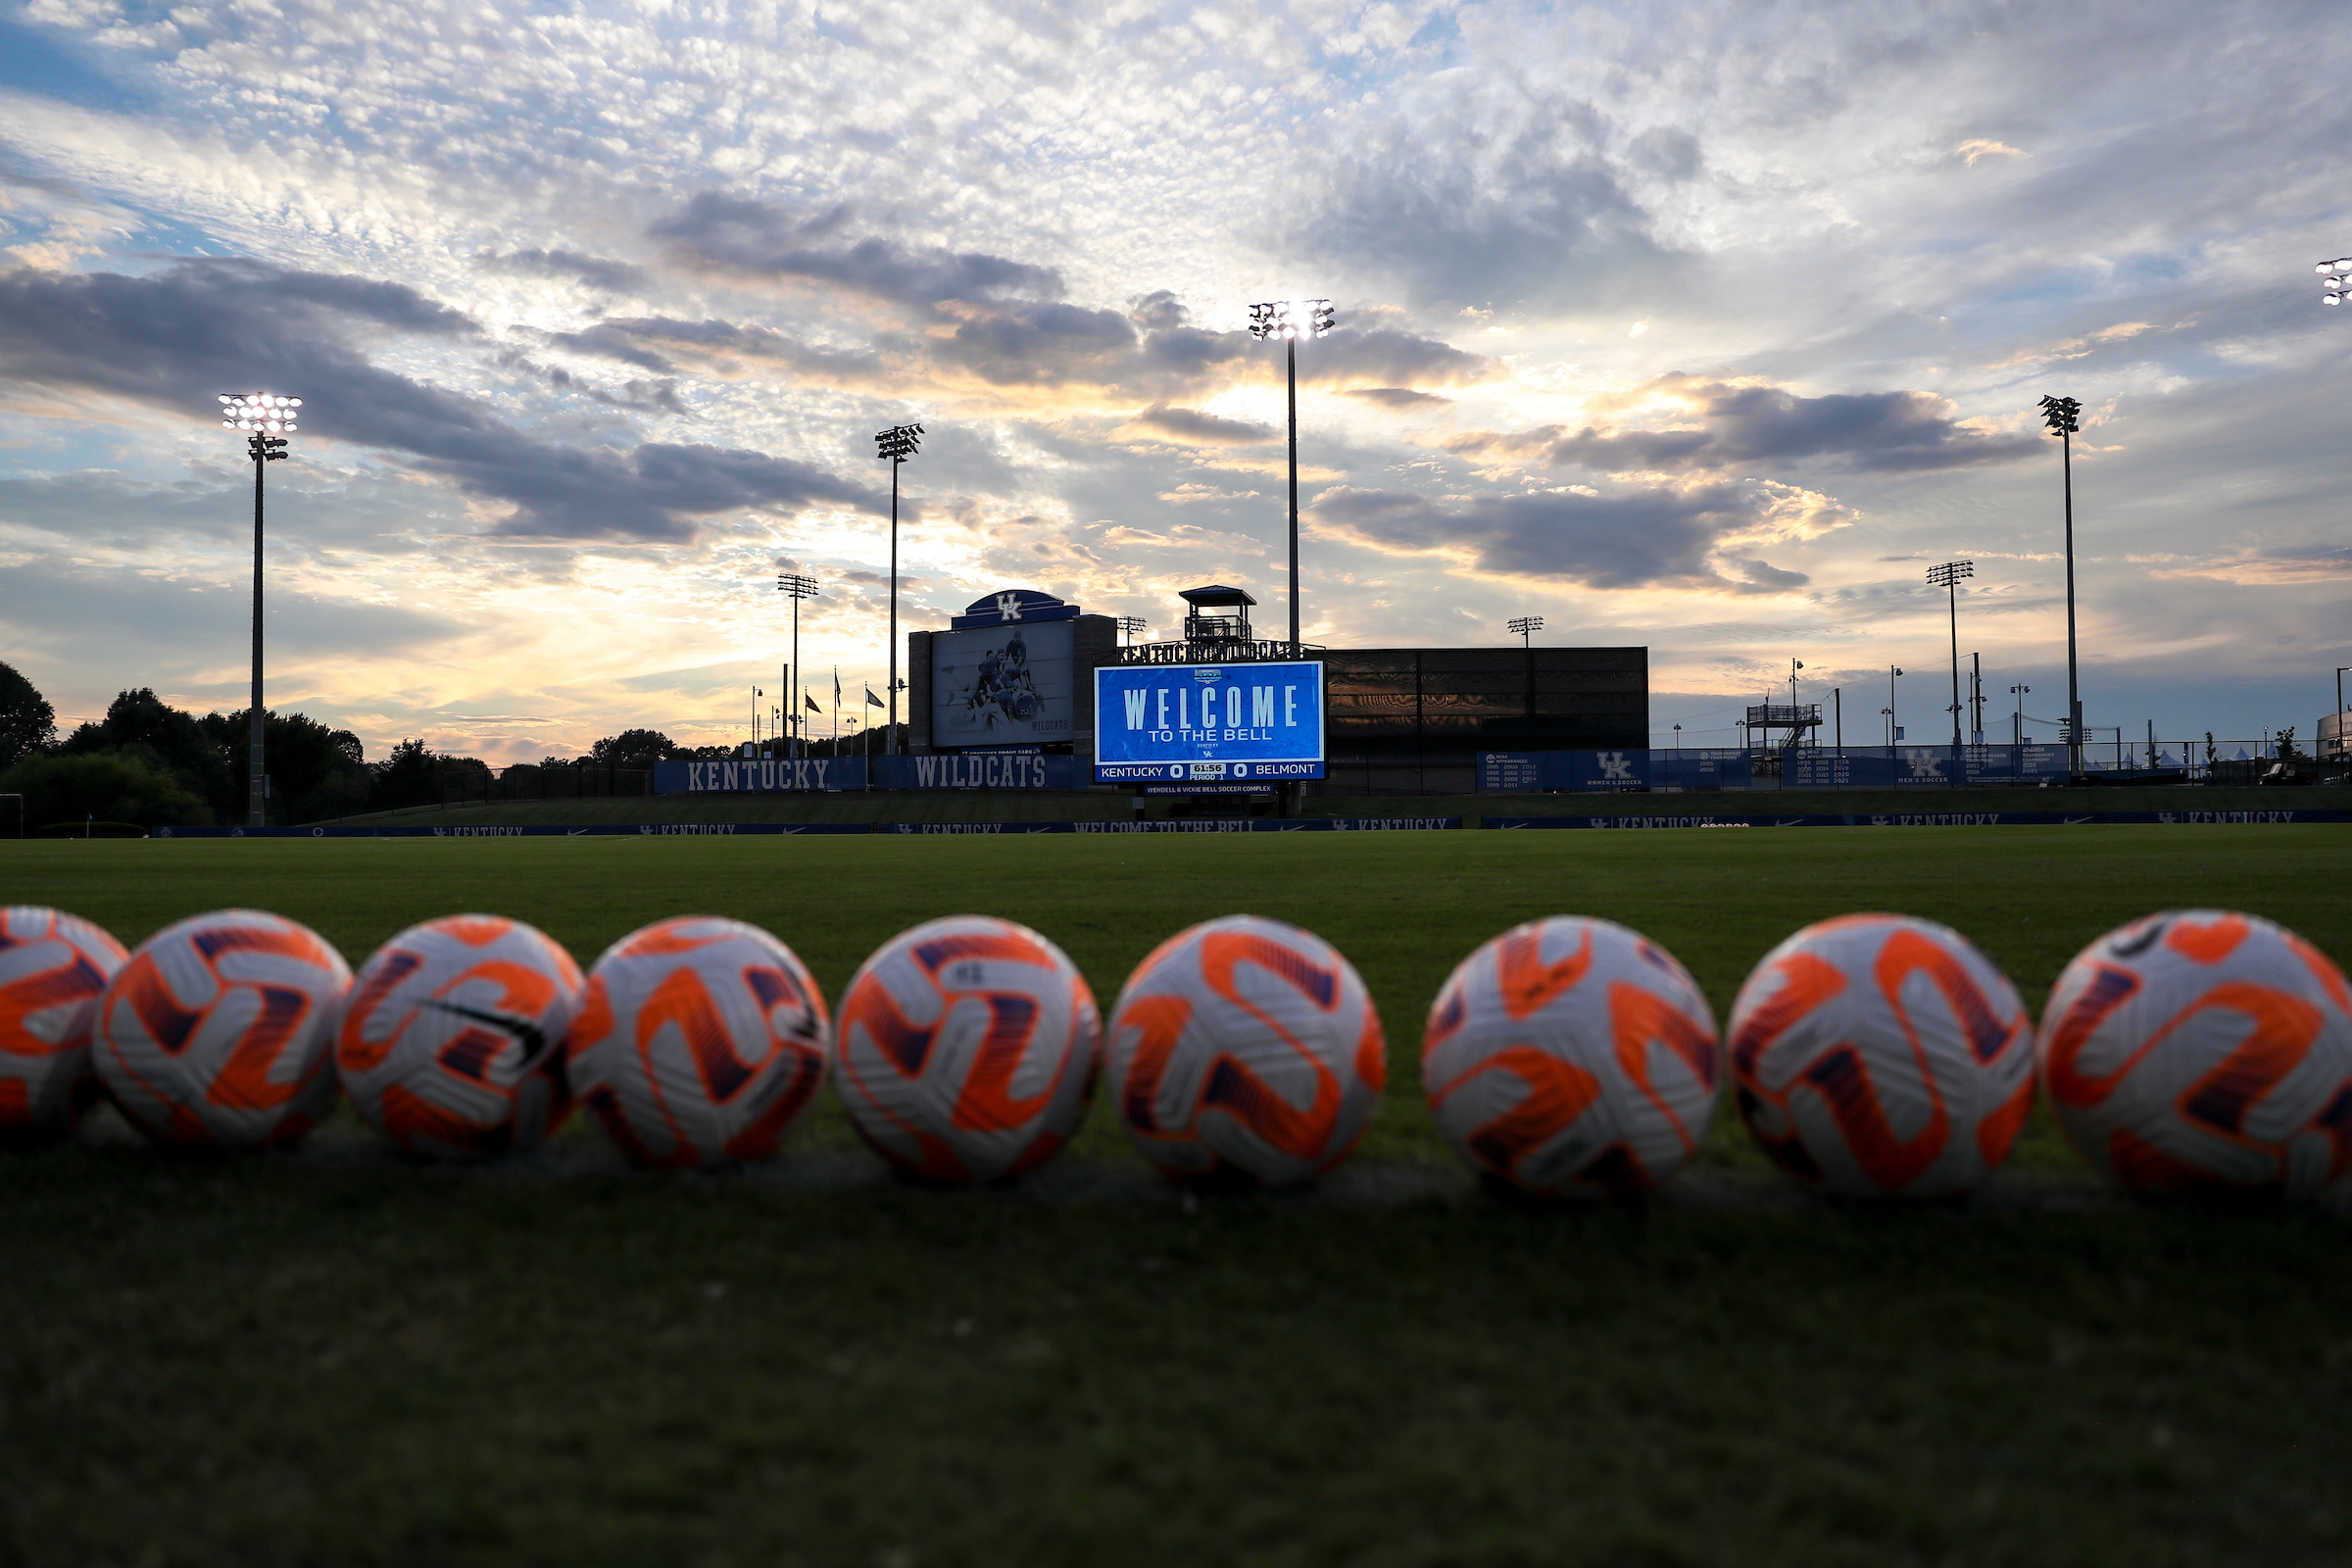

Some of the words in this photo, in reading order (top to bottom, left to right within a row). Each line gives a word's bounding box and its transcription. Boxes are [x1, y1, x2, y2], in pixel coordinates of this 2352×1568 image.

[996, 592, 1022, 621] UK
[1124, 685, 1298, 731] WELCOME
[1031, 719, 1068, 731] WILDCATS
[1148, 730, 1174, 742] TO
[1179, 729, 1217, 742] THE
[1224, 728, 1273, 741] BELL
[1233, 762, 1248, 778] 0
[1255, 763, 1315, 775] BELMONT
[1596, 752, 1632, 779] UK
[1904, 749, 1941, 777] UK
[688, 760, 829, 791] KENTUCKY
[914, 756, 1046, 788] WILDCATS
[1102, 766, 1163, 778] KENTUCKY
[1169, 763, 1184, 779] 0
[1358, 817, 1447, 831] KENTUCKY
[1899, 813, 1999, 826] KENTUCKY
[2188, 811, 2293, 823] KENTUCKY
[454, 826, 523, 836] KENTUCKY
[661, 824, 736, 835] KENTUCKY
[922, 823, 1003, 834] KENTUCKY
[1073, 821, 1152, 833] WELCOME
[1155, 821, 1176, 832] TO
[1180, 821, 1213, 832] THE
